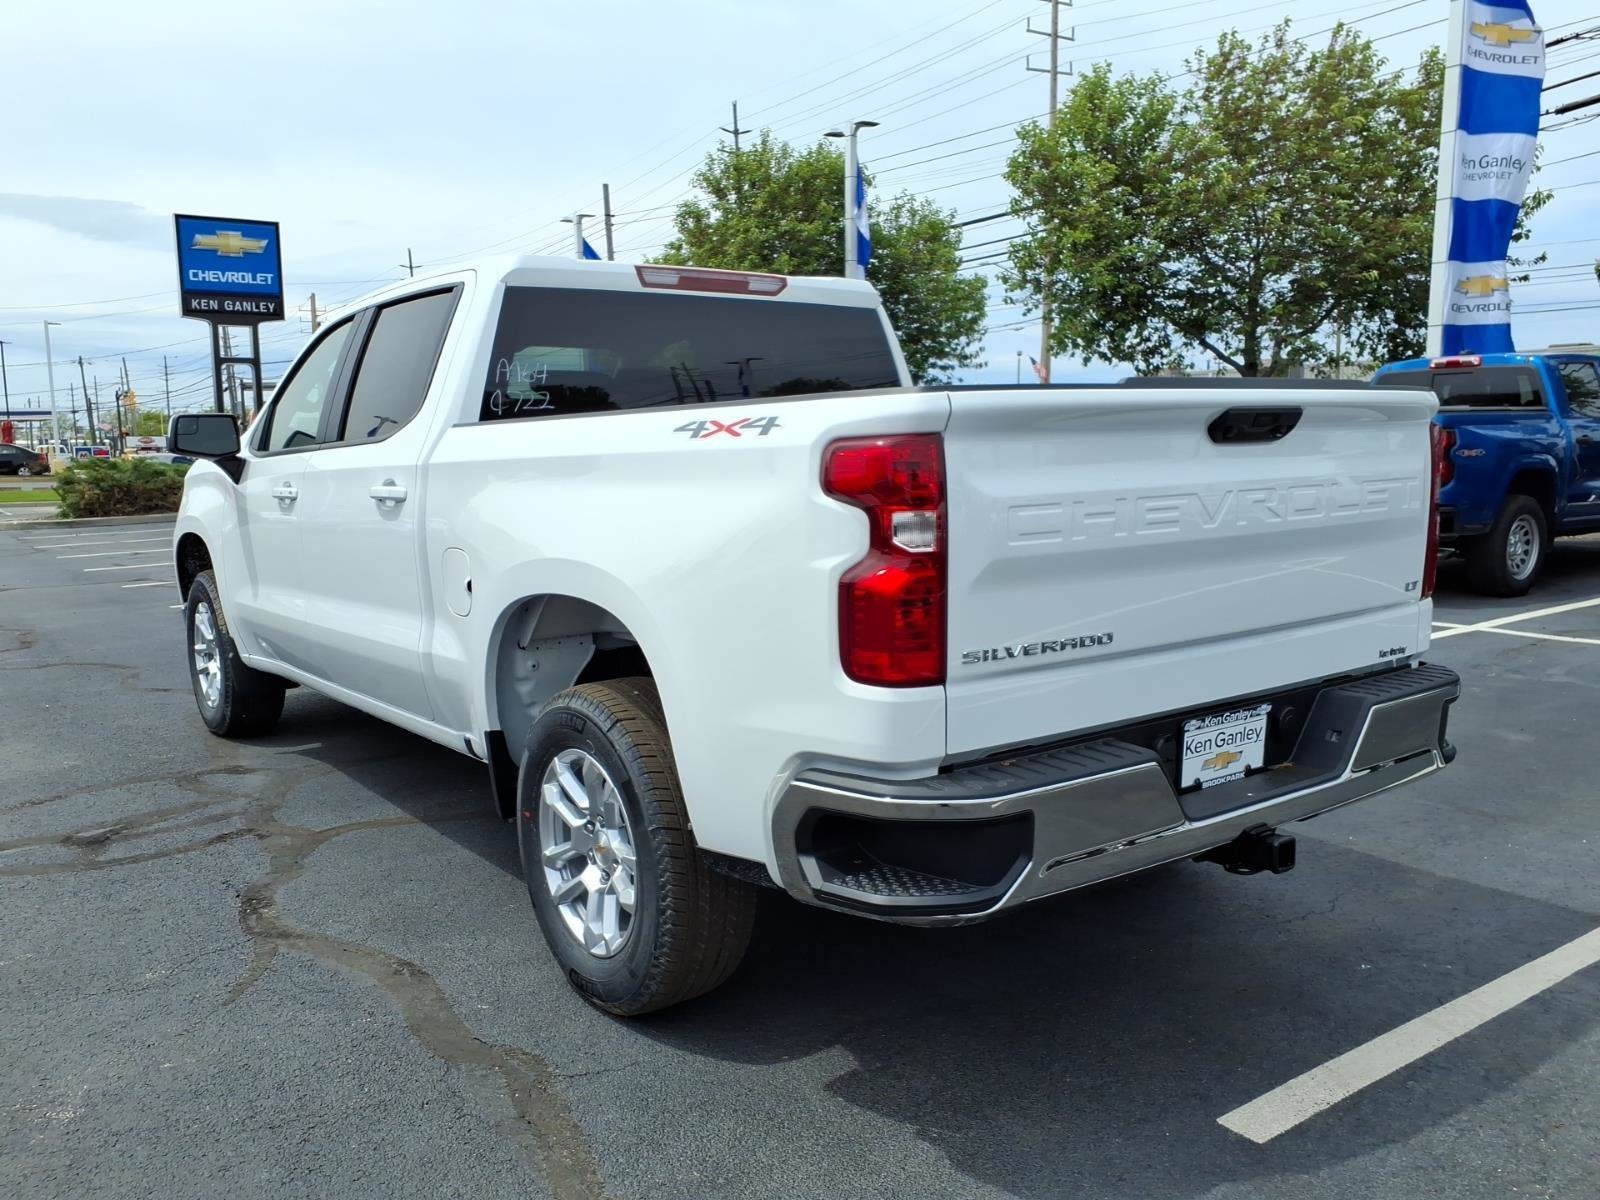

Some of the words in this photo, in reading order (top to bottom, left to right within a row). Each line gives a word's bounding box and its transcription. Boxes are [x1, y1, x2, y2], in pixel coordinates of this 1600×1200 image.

[1467, 45, 1540, 65] CHEVROLET
[1479, 154, 1527, 173] Ganley
[189, 269, 274, 285] CHEVROLET
[191, 298, 218, 310] KEN
[224, 300, 276, 313] GANLEY
[1006, 475, 1421, 547] CHEVROLET
[1404, 580, 1419, 593] LT
[961, 631, 1114, 666] SILVERADO
[1204, 715, 1222, 727] Ken
[1222, 709, 1252, 724] Ganley
[1184, 737, 1213, 758] Ken
[1214, 726, 1264, 748] Ganley
